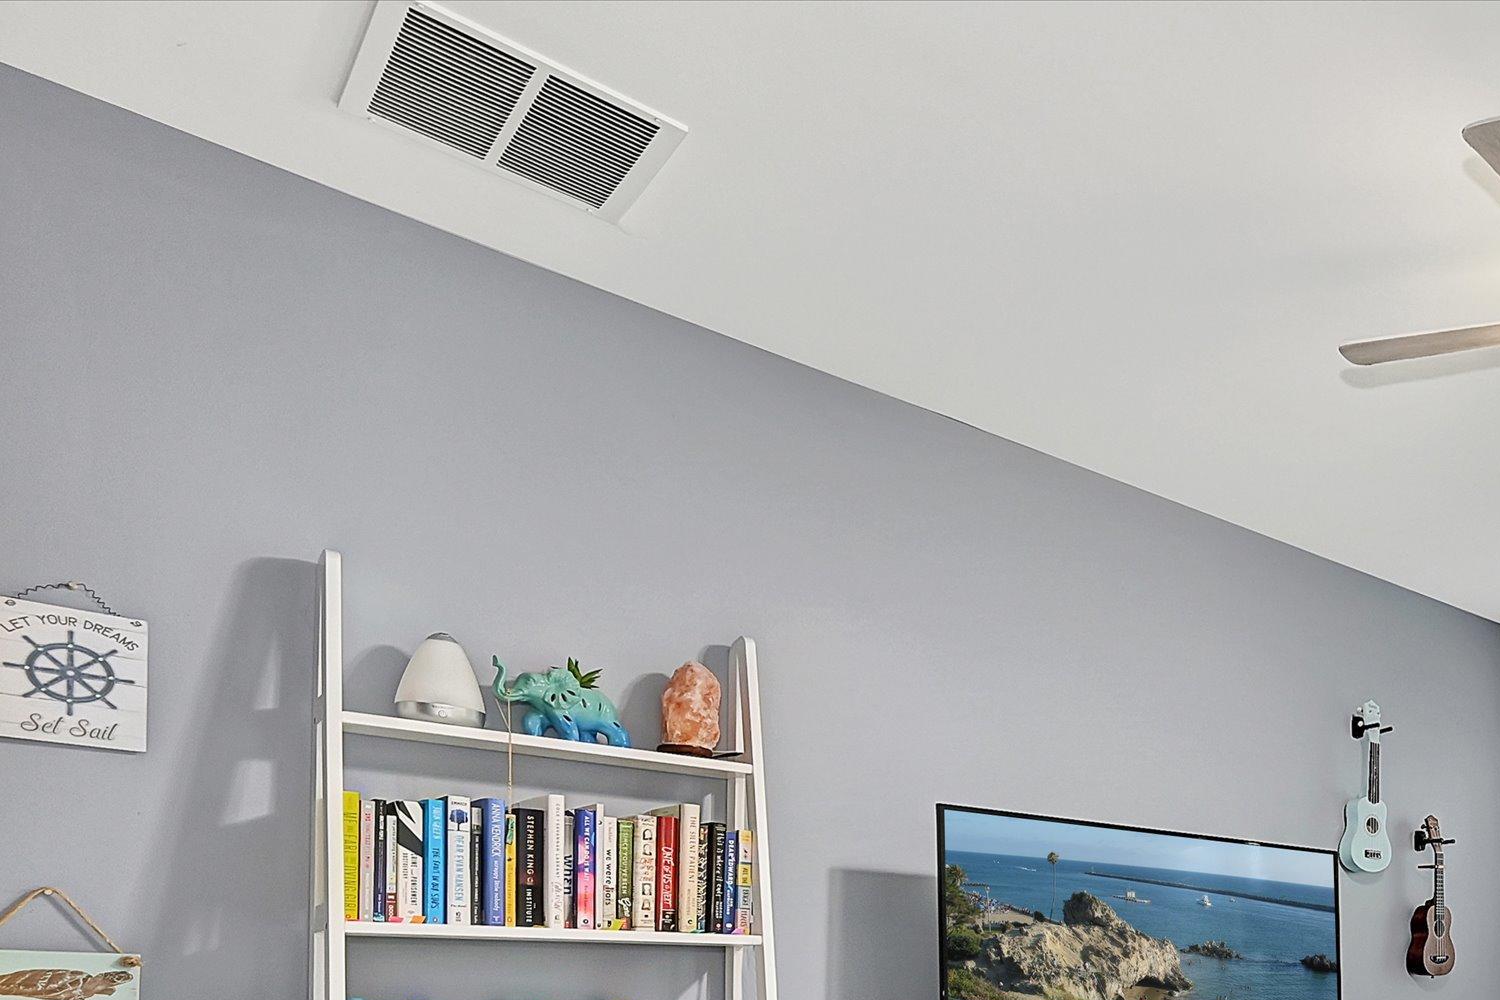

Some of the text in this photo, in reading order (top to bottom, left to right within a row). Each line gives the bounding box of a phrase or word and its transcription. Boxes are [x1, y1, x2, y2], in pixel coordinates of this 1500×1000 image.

[0, 614, 139, 651] LET YOUR DREAMS
[20, 712, 119, 741] Set Sail
[491, 803, 501, 857] ANNA KENDRICK
[583, 827, 590, 836] WE
[689, 816, 698, 828] THE
[526, 815, 535, 875] STEPHEN KING
[689, 831, 697, 854] SILENT
[410, 853, 418, 868] RIME
[605, 849, 612, 861] we
[661, 846, 674, 866] ONE
[726, 839, 736, 885] DEAR EDWARD
[605, 863, 613, 885] were
[688, 856, 696, 884] PATIENT
[525, 888, 533, 923] INSTITUTE
[604, 887, 615, 906] liars
[617, 897, 632, 917] Gone
